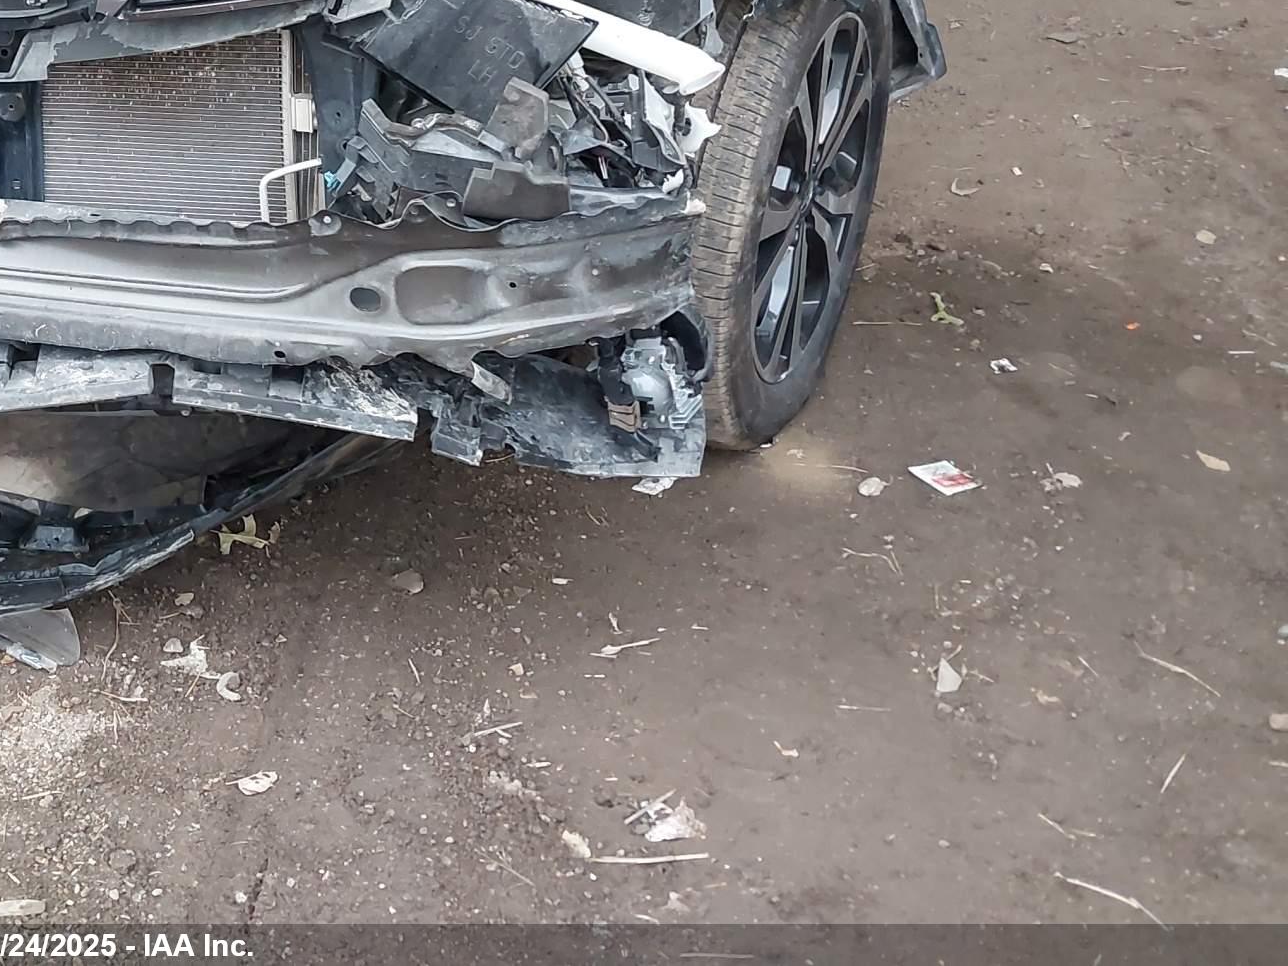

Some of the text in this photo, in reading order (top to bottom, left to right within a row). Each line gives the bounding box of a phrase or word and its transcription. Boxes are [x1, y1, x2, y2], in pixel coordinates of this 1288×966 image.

[454, 15, 526, 70] SJ STD
[467, 59, 499, 88] LH
